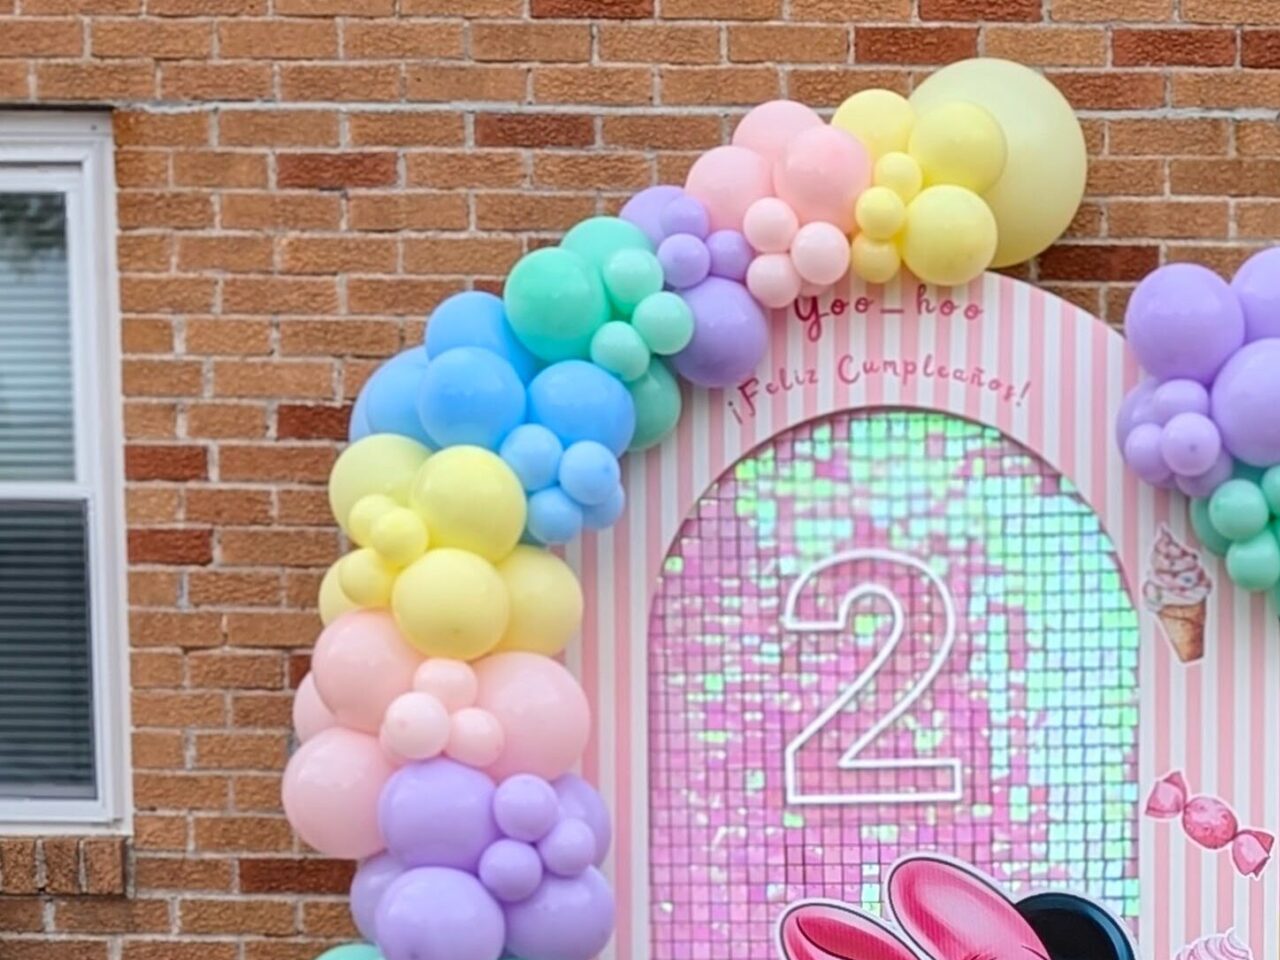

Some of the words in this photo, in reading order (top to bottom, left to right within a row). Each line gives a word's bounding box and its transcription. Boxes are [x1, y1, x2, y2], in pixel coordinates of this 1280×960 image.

[728, 367, 818, 424] ¡Feliz
[837, 354, 1031, 406] Cumpleaños!
[784, 548, 963, 804] 2
